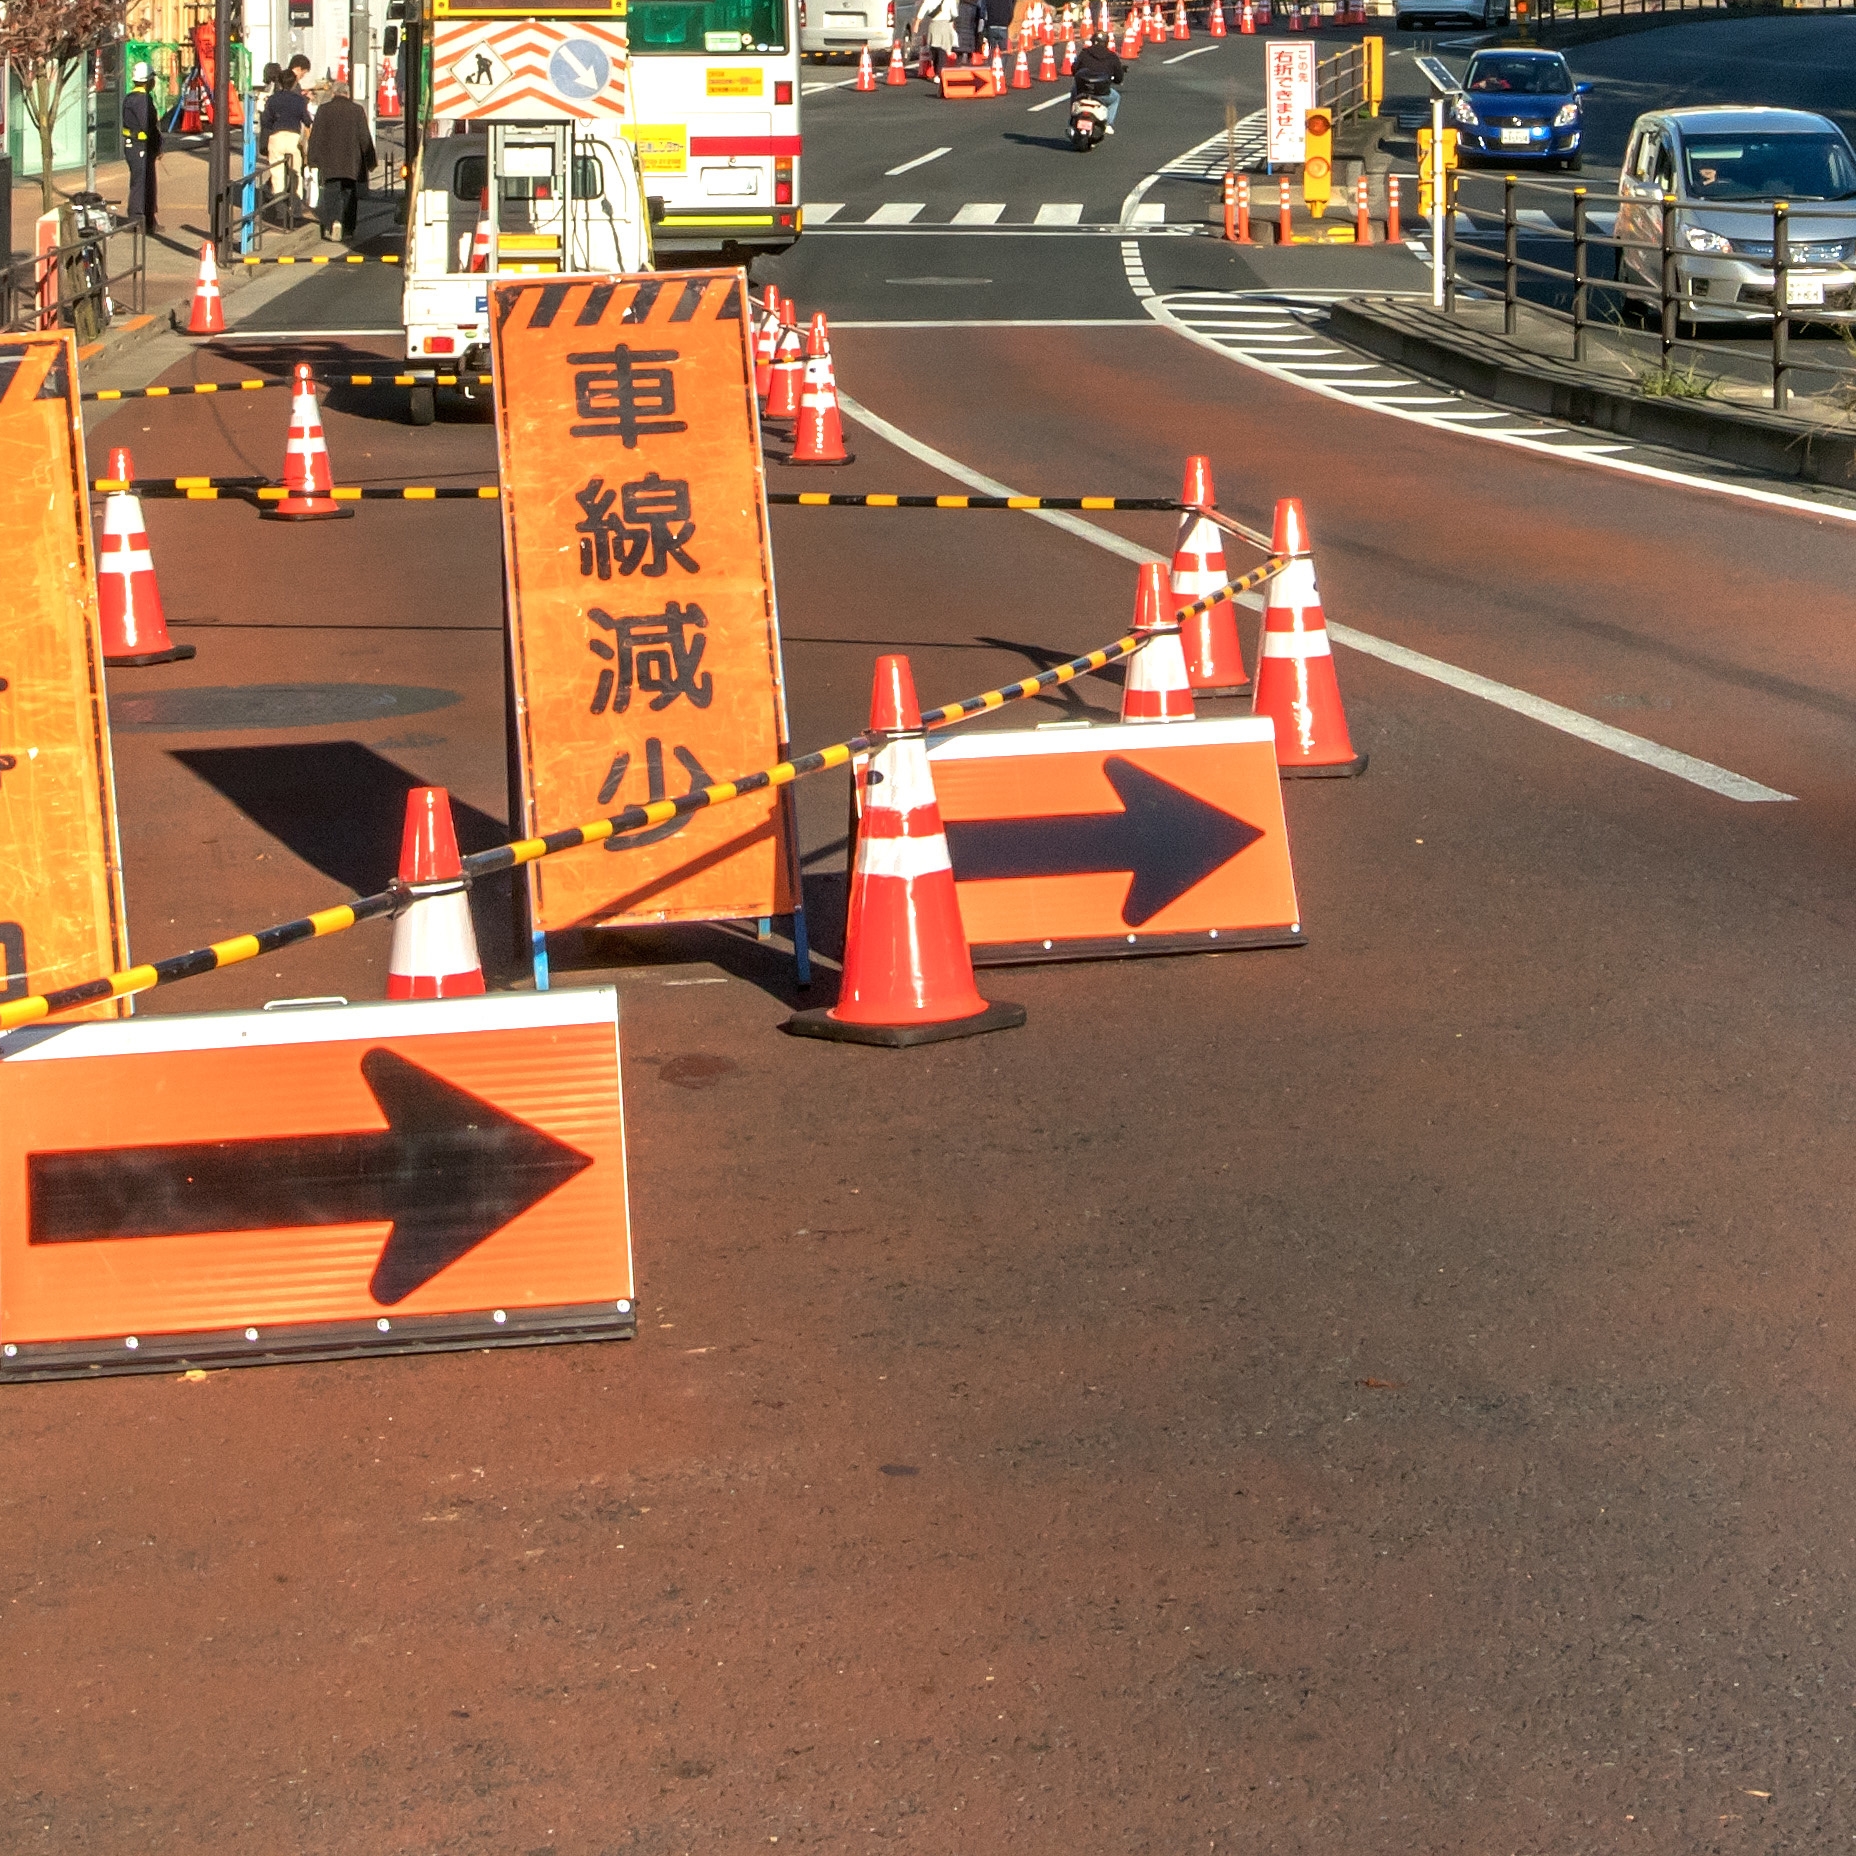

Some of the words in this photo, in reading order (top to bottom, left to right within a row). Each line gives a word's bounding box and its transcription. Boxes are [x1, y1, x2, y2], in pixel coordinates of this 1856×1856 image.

[1298, 50, 1308, 82] この先
[566, 344, 717, 852] 車線減少
